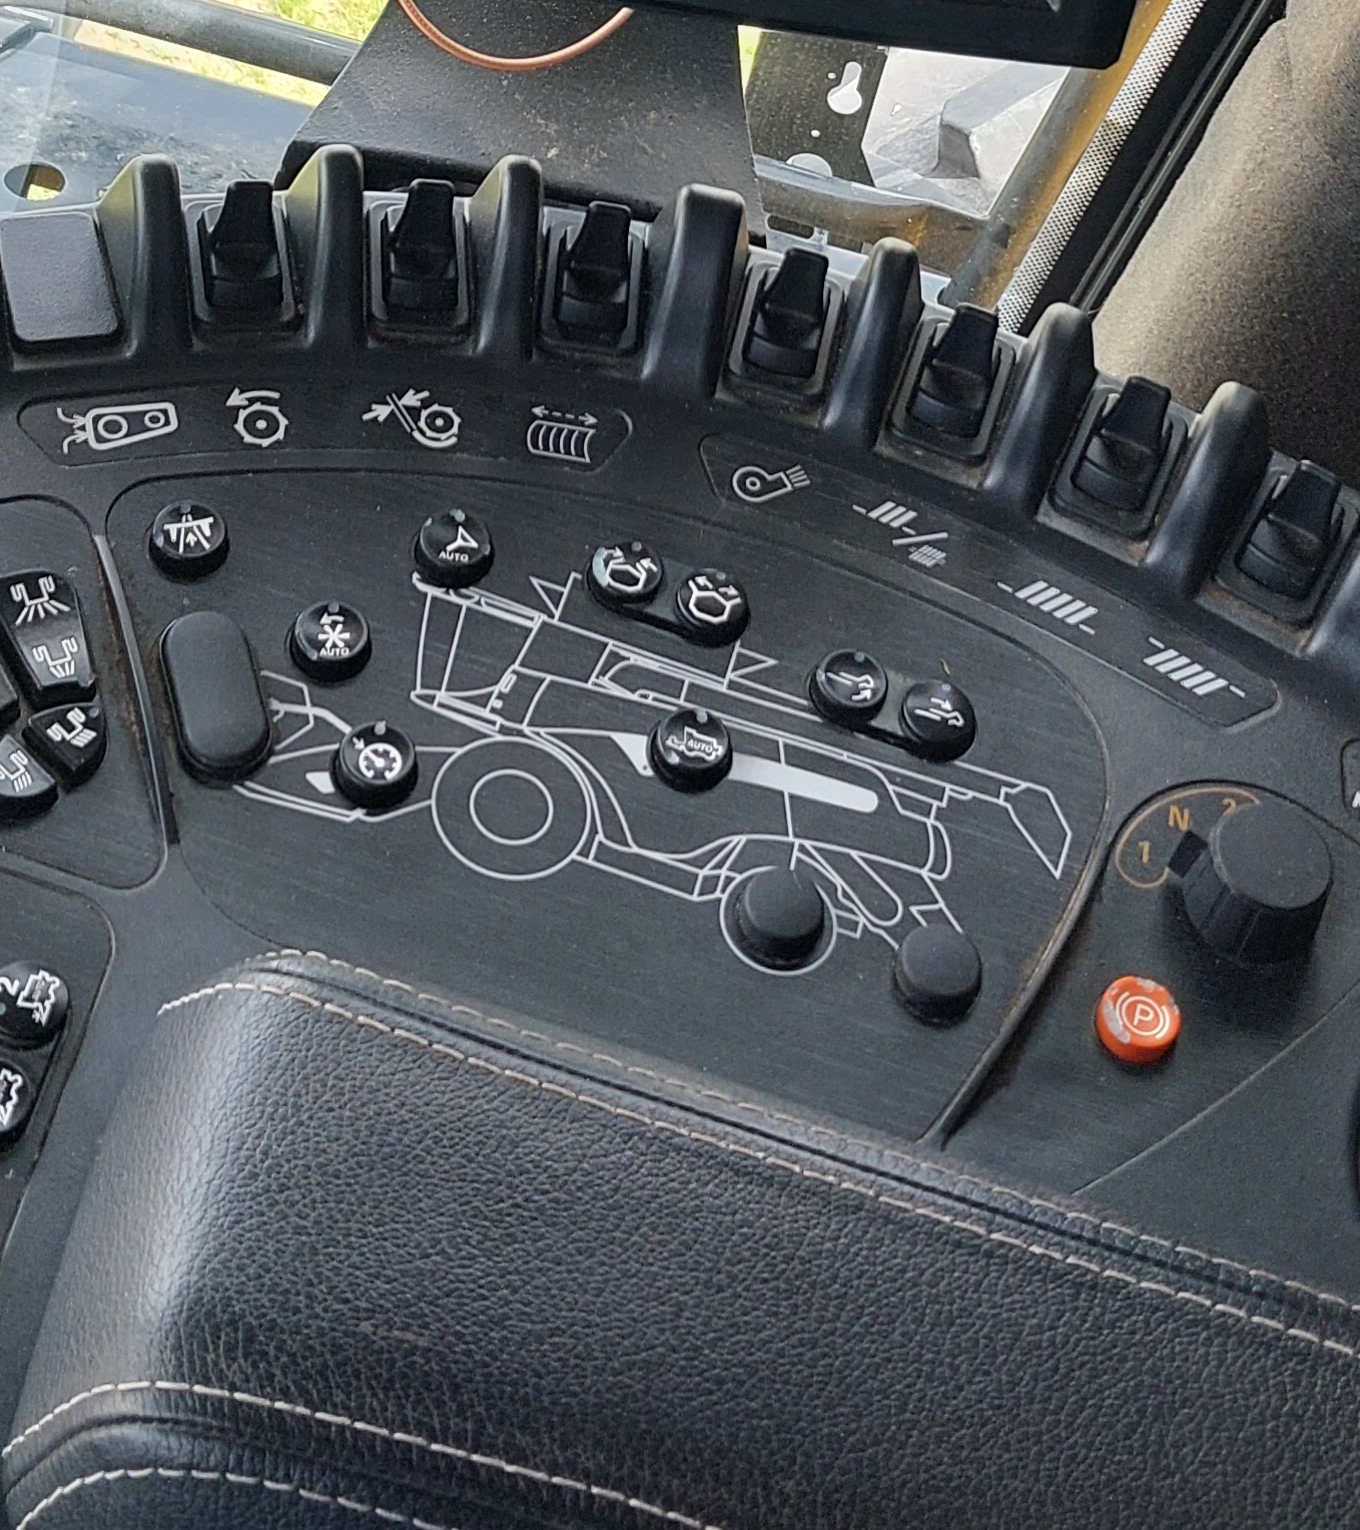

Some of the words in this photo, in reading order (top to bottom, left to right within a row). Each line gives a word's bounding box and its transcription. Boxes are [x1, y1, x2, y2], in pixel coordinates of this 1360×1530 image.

[438, 550, 469, 563] AUTO
[319, 647, 350, 657] AUTO
[686, 738, 713, 753] AUTO
[1138, 840, 1151, 864] 1
[1168, 804, 1190, 831] N
[1133, 1003, 1154, 1026] P
